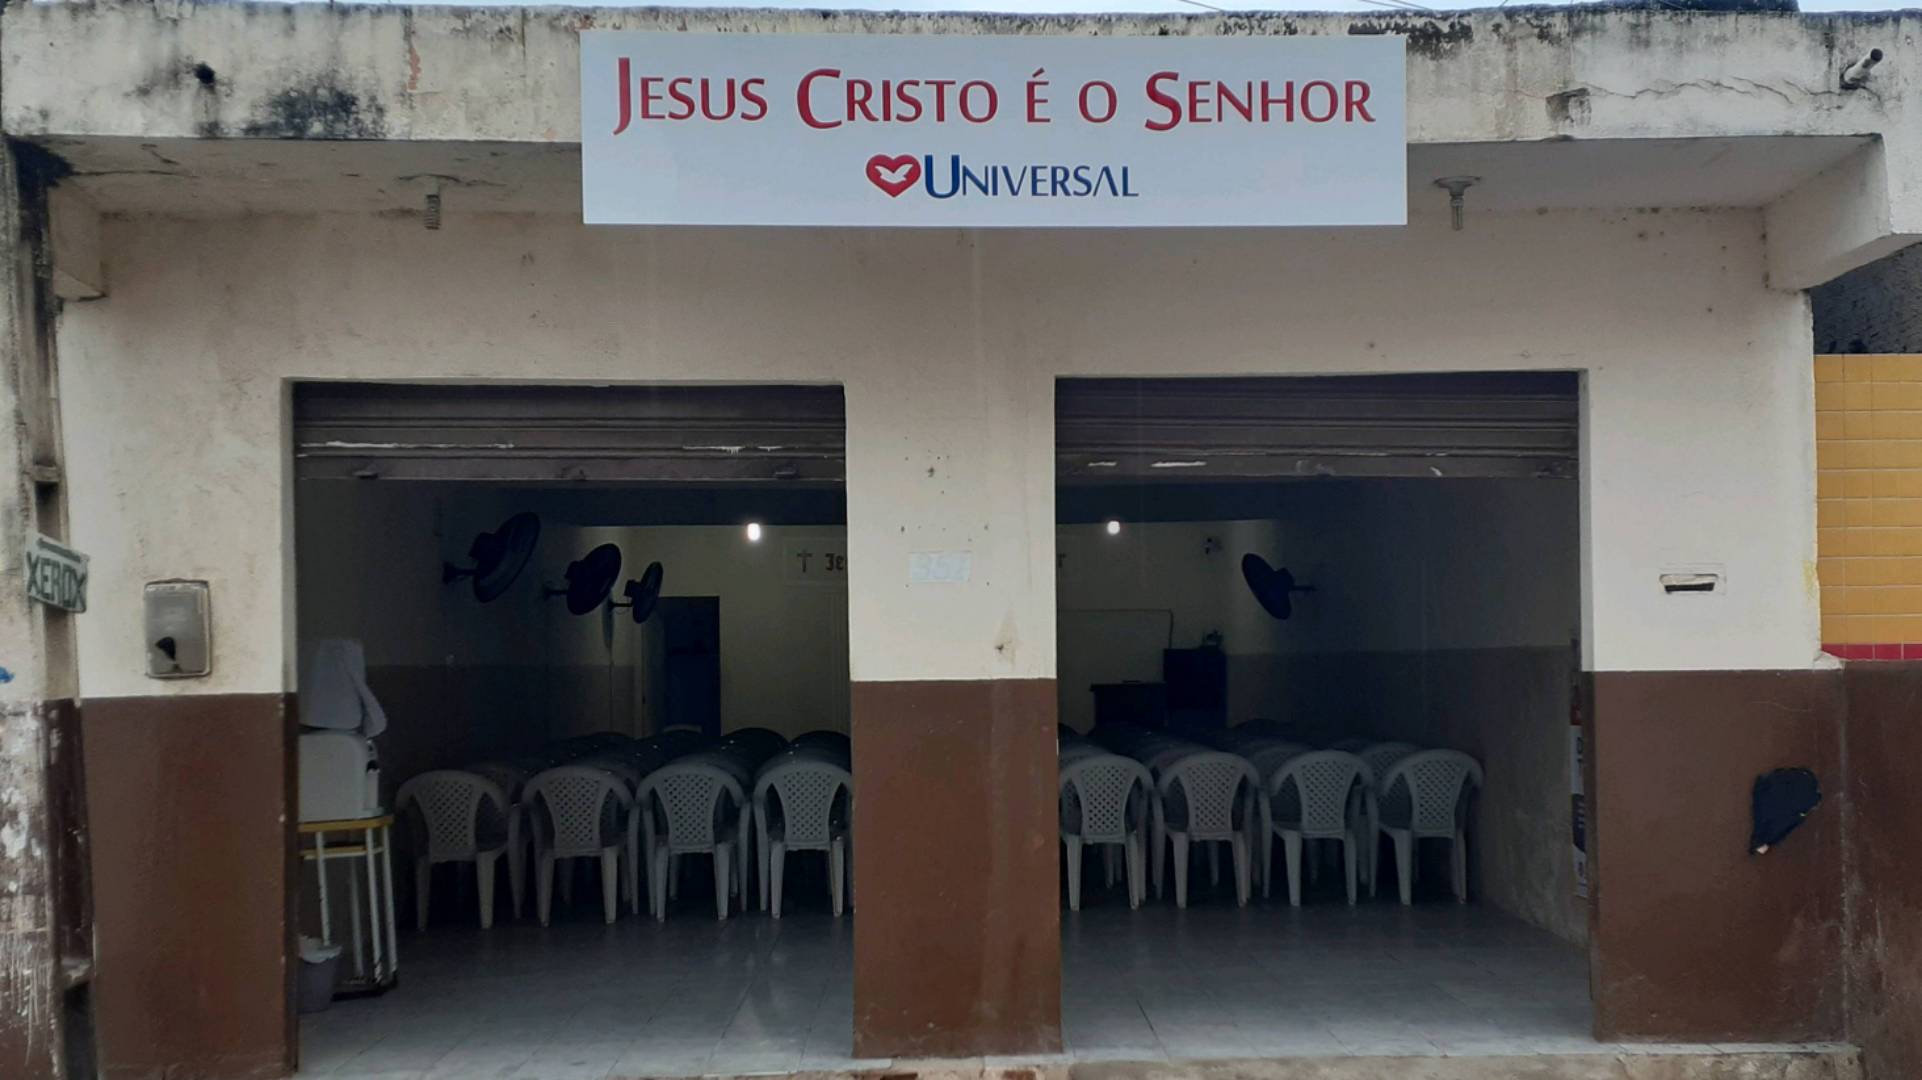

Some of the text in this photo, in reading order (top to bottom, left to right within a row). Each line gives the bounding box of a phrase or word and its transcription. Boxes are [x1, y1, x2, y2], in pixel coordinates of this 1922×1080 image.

[613, 57, 1376, 135] JESUS CRISTO É O SENHOR
[924, 154, 1139, 199] UNIVERSAL
[26, 551, 87, 609] XEROX
